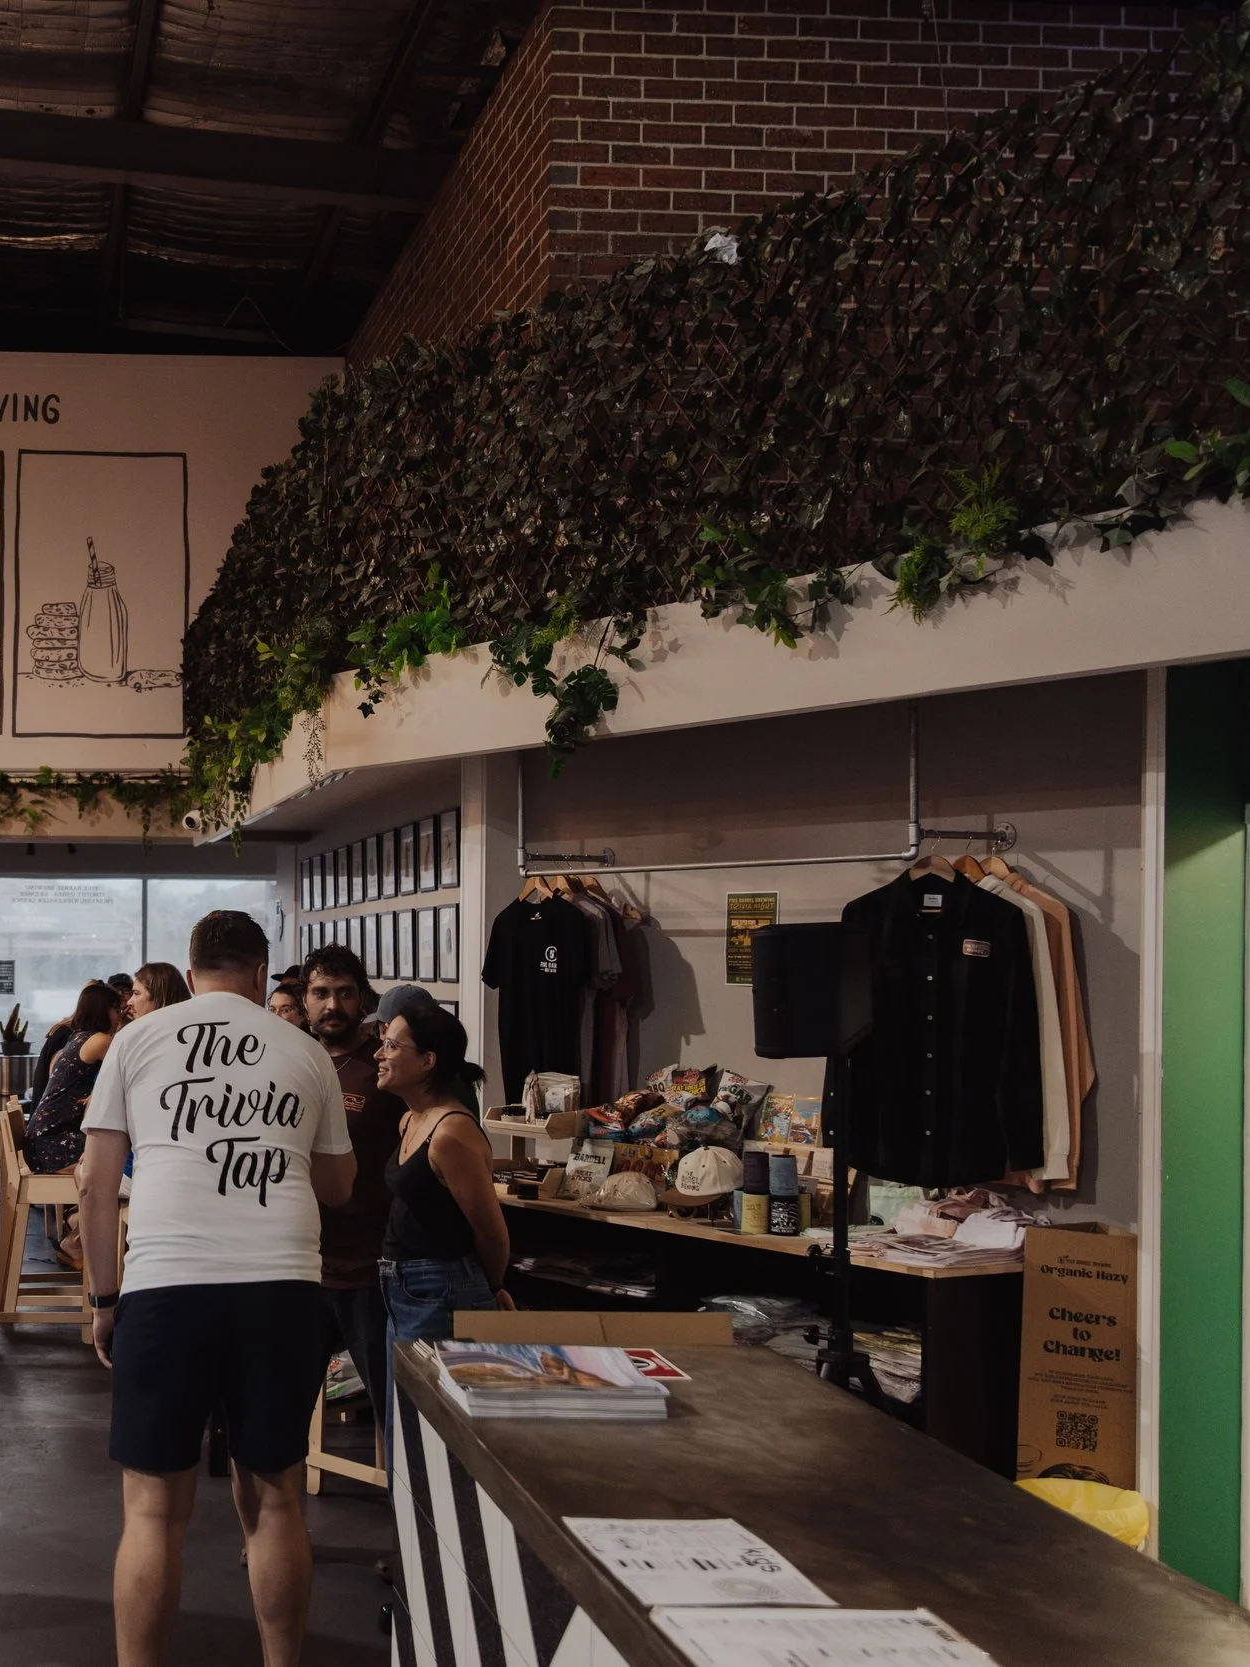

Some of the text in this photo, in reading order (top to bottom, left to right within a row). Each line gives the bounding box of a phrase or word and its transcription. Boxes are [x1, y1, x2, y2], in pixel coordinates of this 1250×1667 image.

[730, 902, 774, 911] TRIVIA NIGHT
[176, 1021, 266, 1074] The
[159, 1076, 305, 1142] Trivia
[205, 1136, 291, 1208] Tap
[1040, 1264, 1129, 1285] Organic Hazy
[1048, 1306, 1117, 1327] Cheers
[1072, 1325, 1092, 1342] to
[1042, 1340, 1121, 1362] Change!
